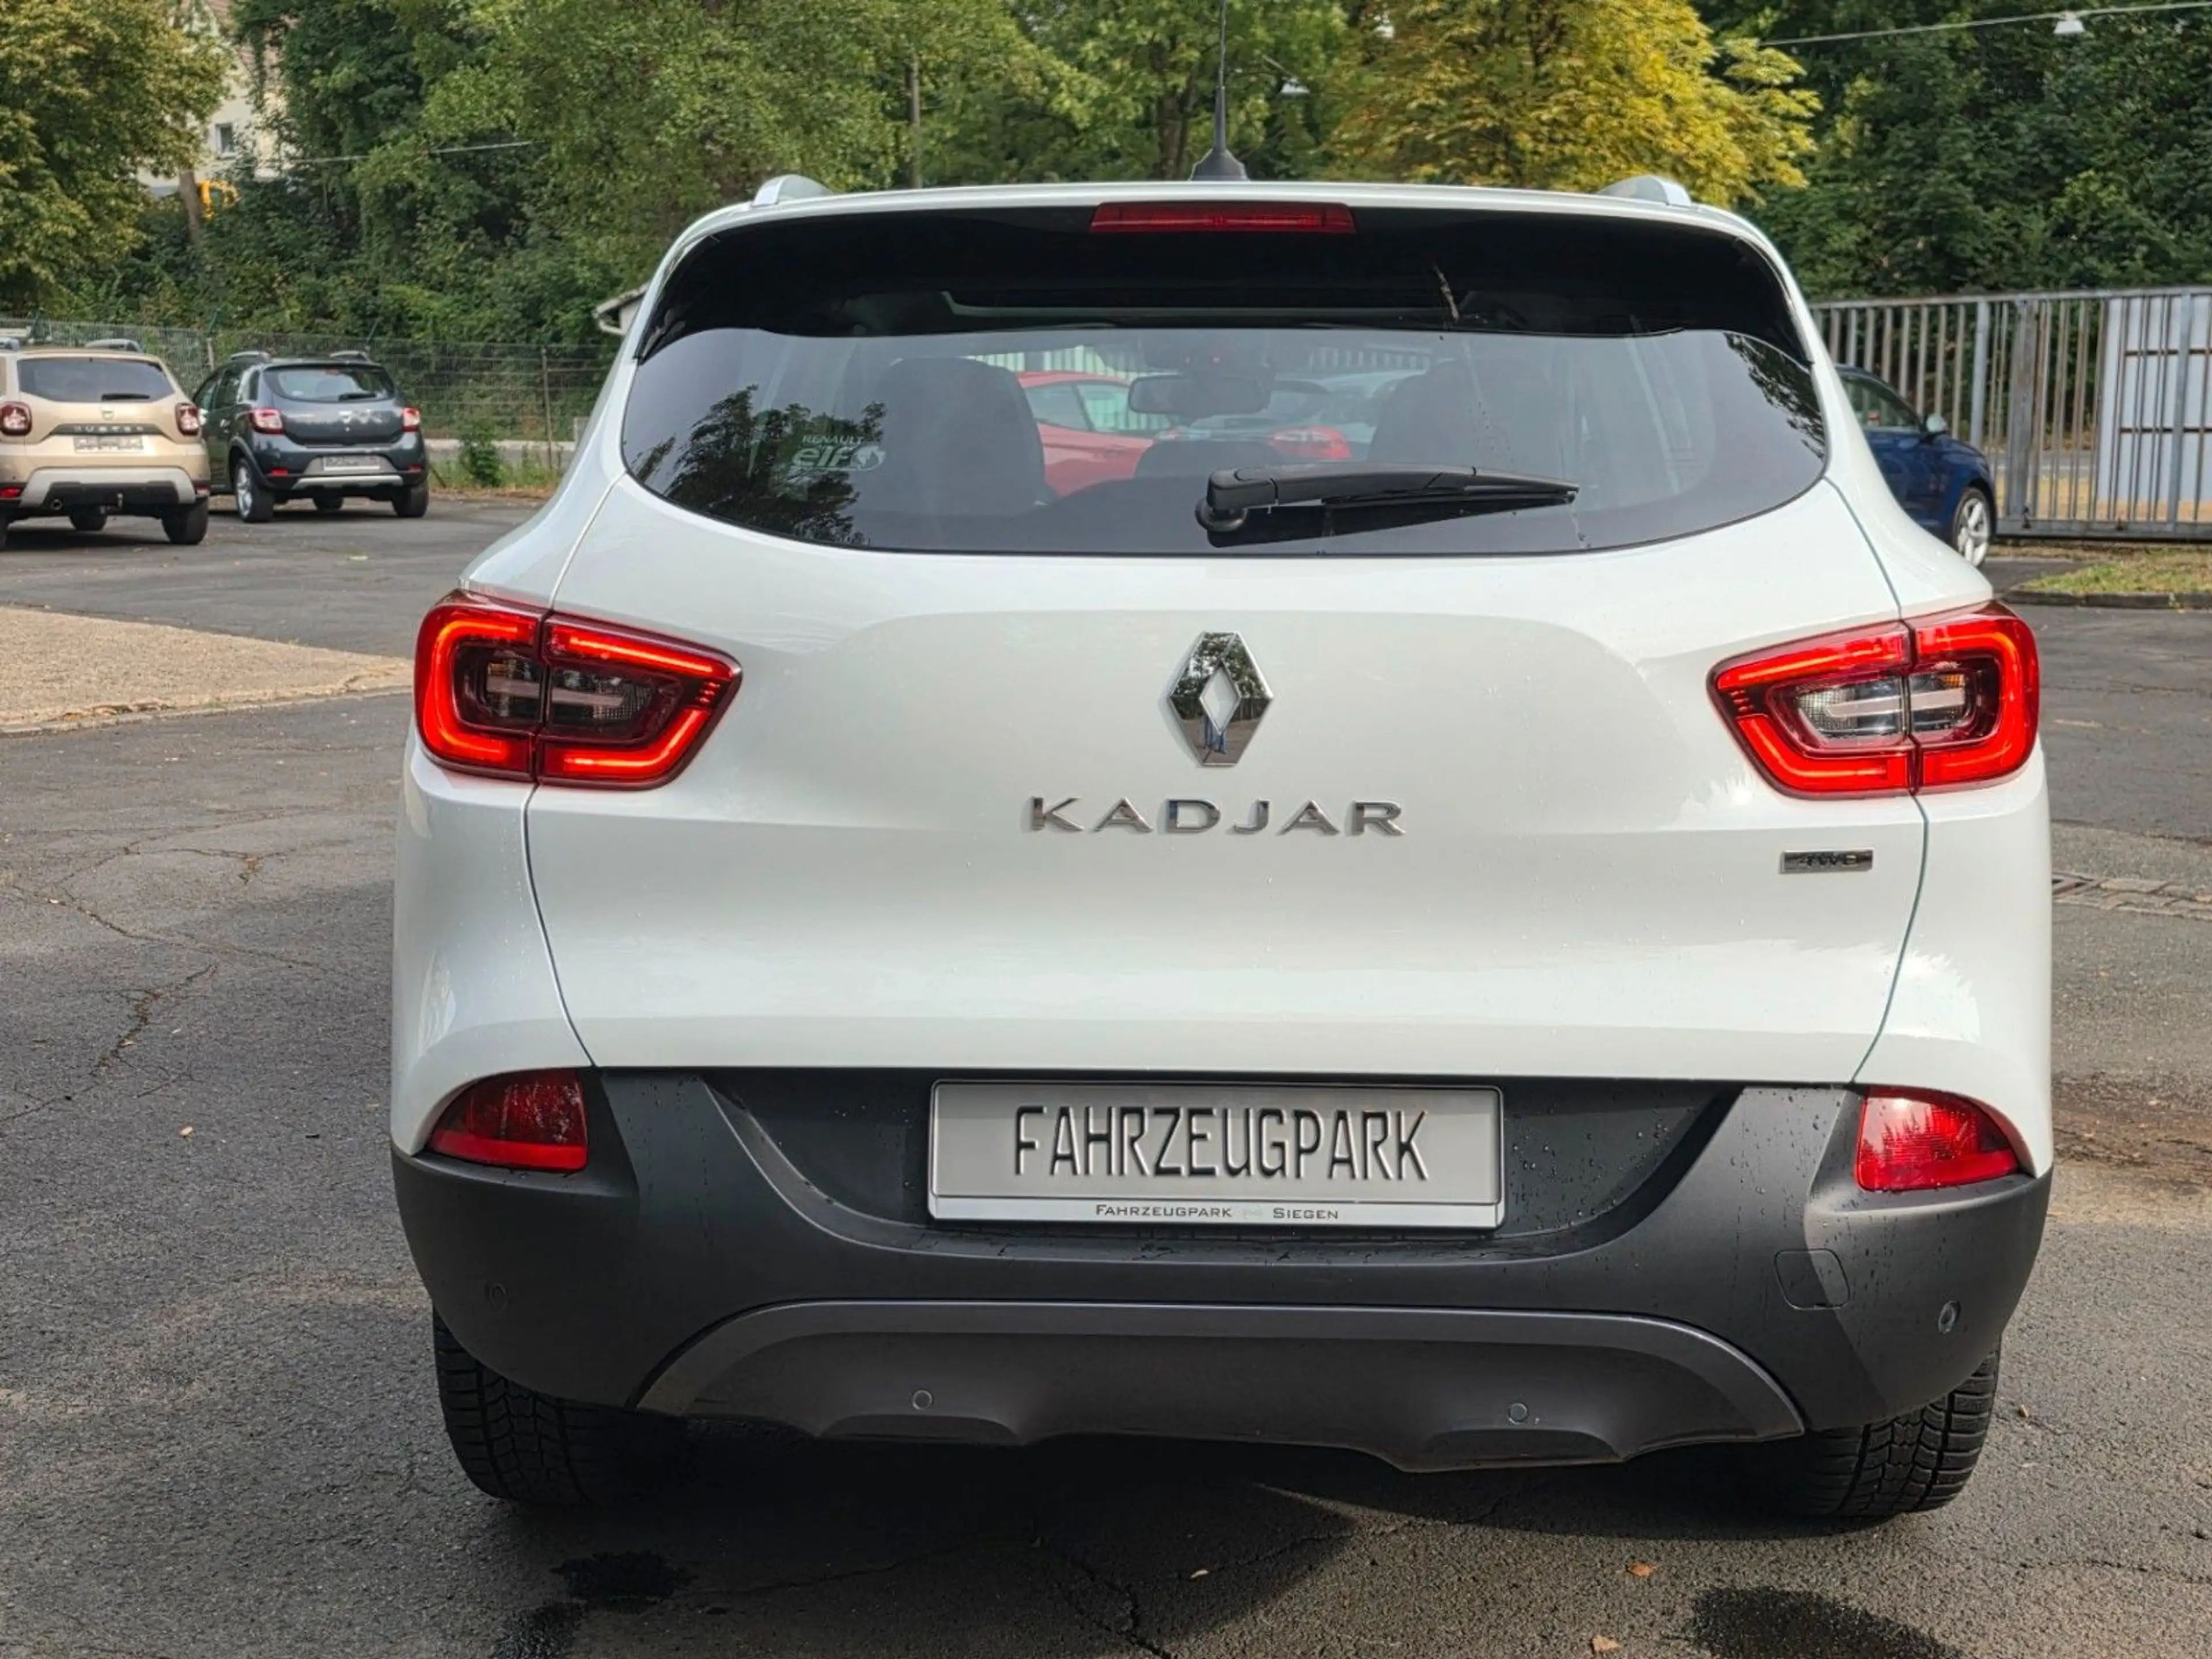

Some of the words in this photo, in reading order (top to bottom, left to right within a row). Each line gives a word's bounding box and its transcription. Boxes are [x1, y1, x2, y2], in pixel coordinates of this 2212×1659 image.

[802, 435, 864, 445] RENAULT
[791, 446, 853, 467] elf
[1030, 796, 1406, 836] KADJAR
[1796, 853, 1859, 869] 4WD
[1014, 1105, 1429, 1180] FAHRZEUGPARK
